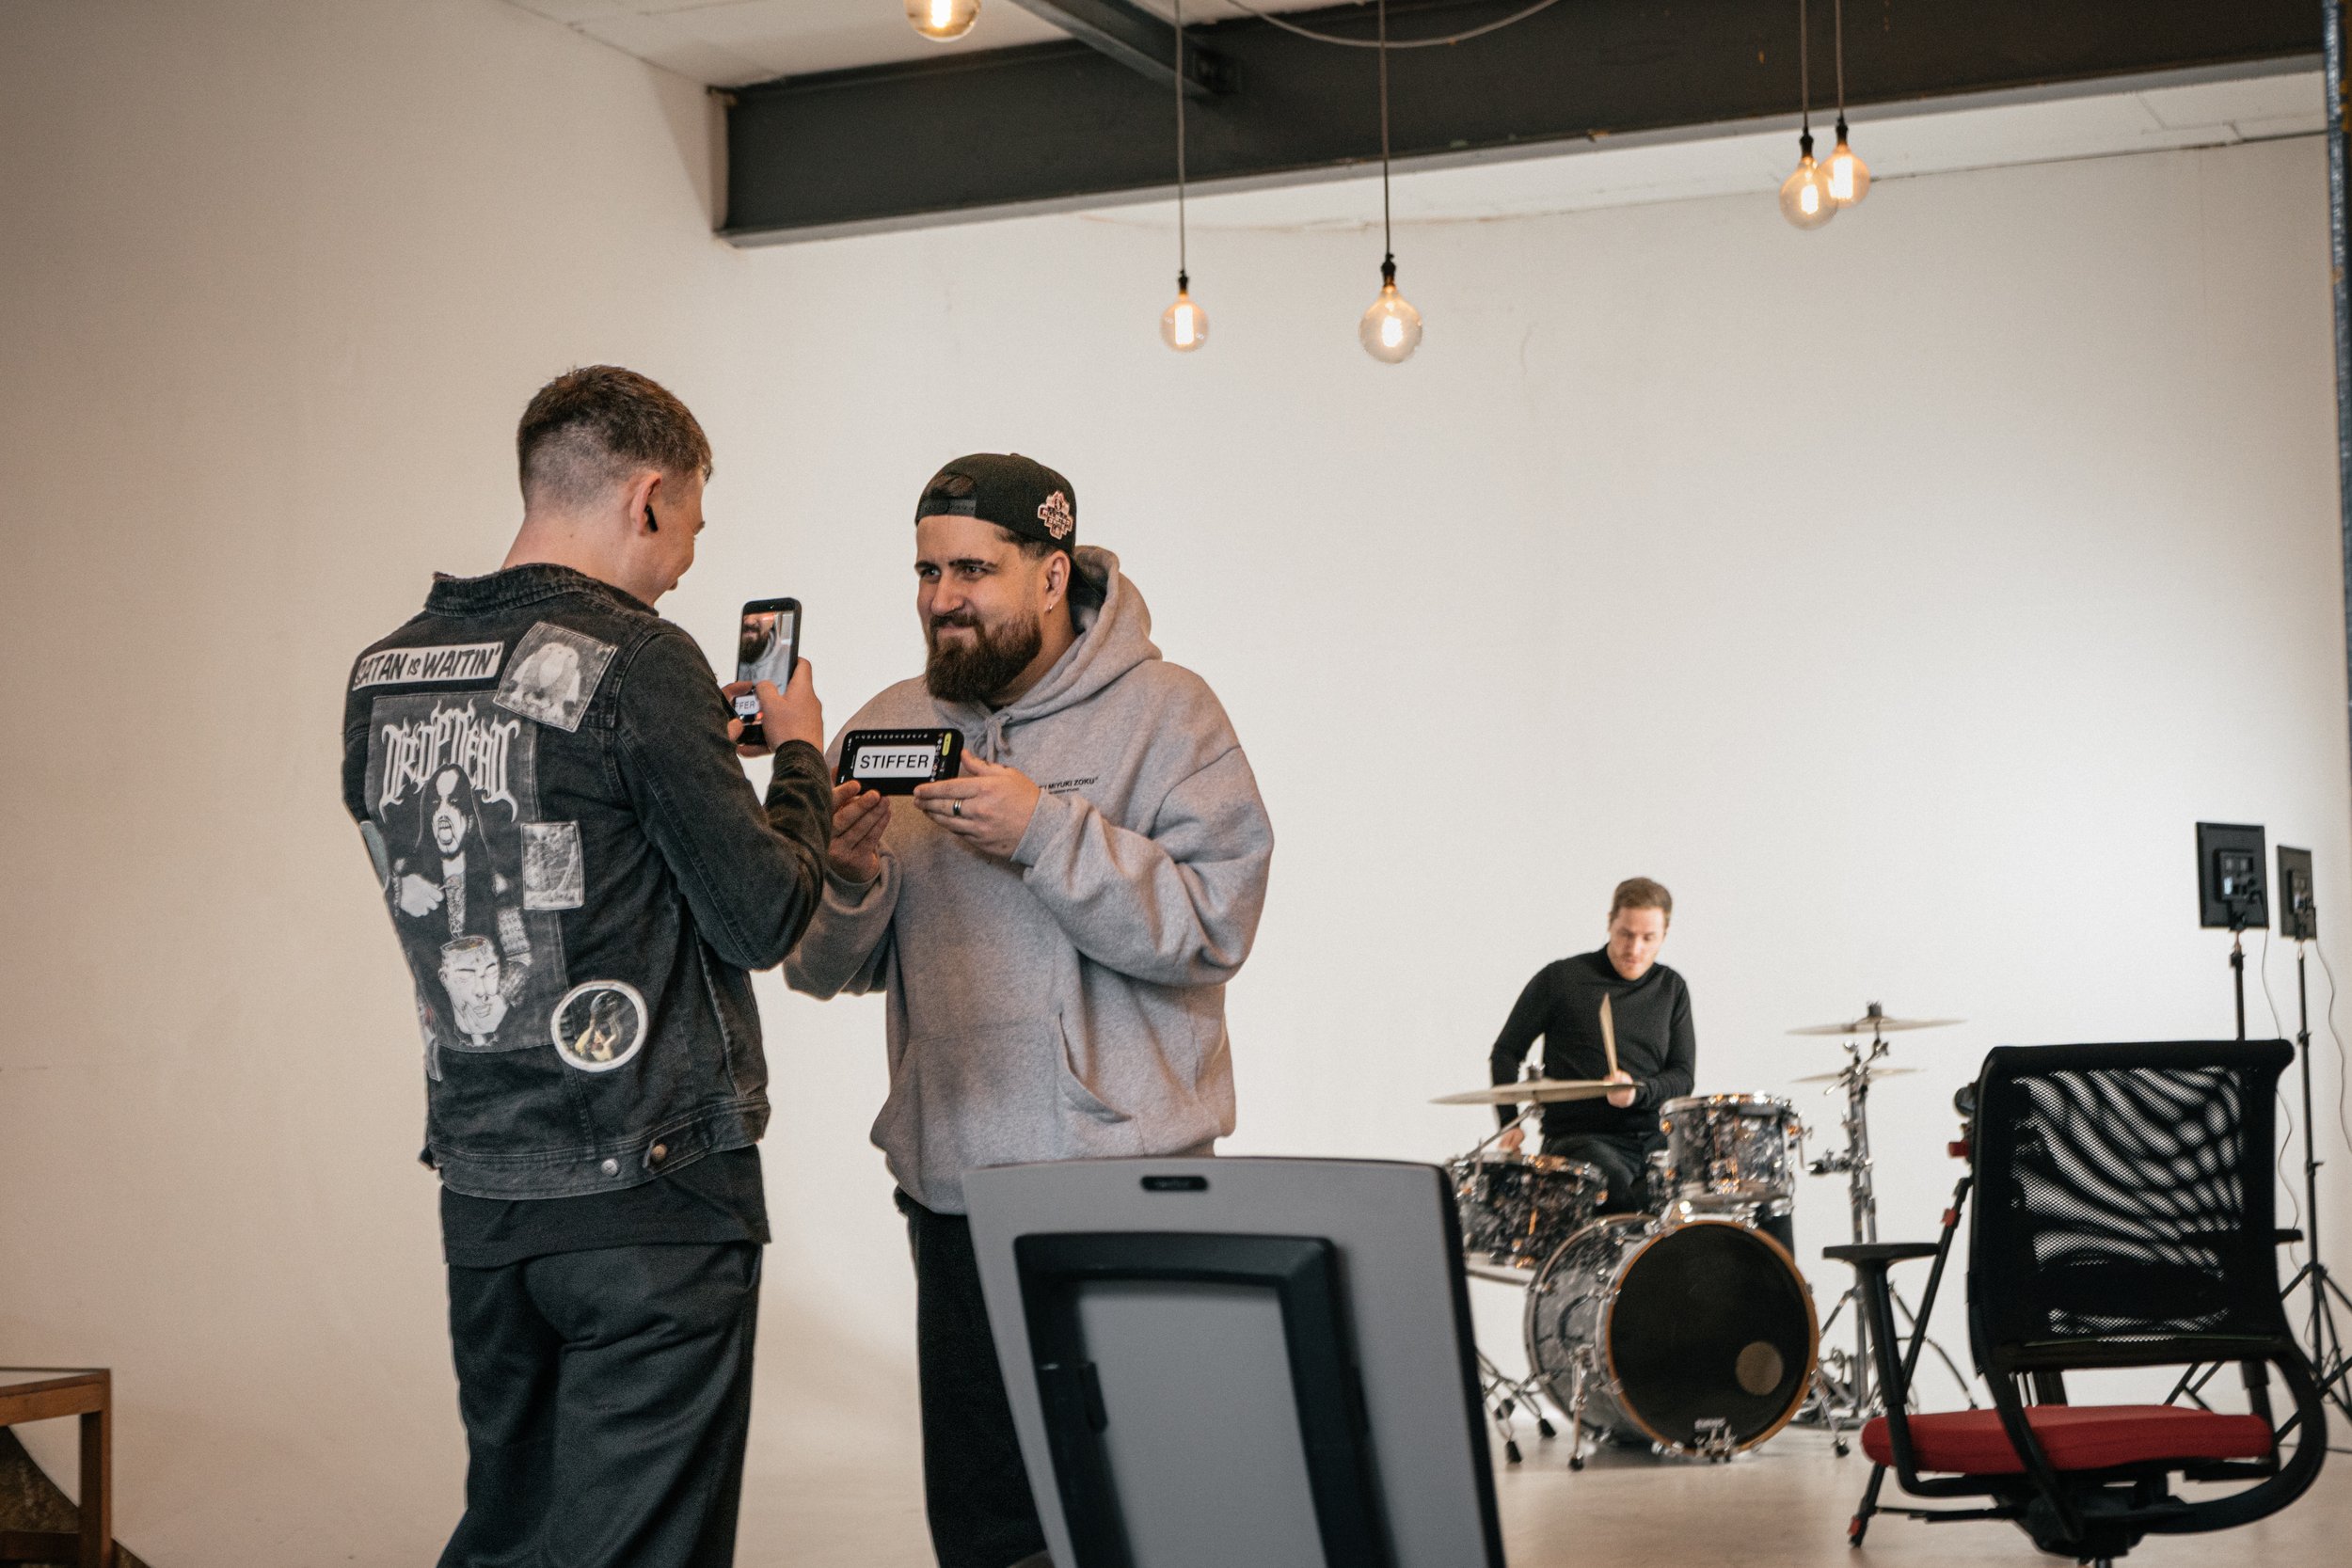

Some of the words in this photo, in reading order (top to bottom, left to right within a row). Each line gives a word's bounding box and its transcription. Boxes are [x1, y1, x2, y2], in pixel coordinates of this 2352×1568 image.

[354, 653, 408, 688] SATAN
[407, 657, 421, 675] IS
[421, 644, 501, 678] WAITIN'
[860, 754, 930, 769] STIFFER
